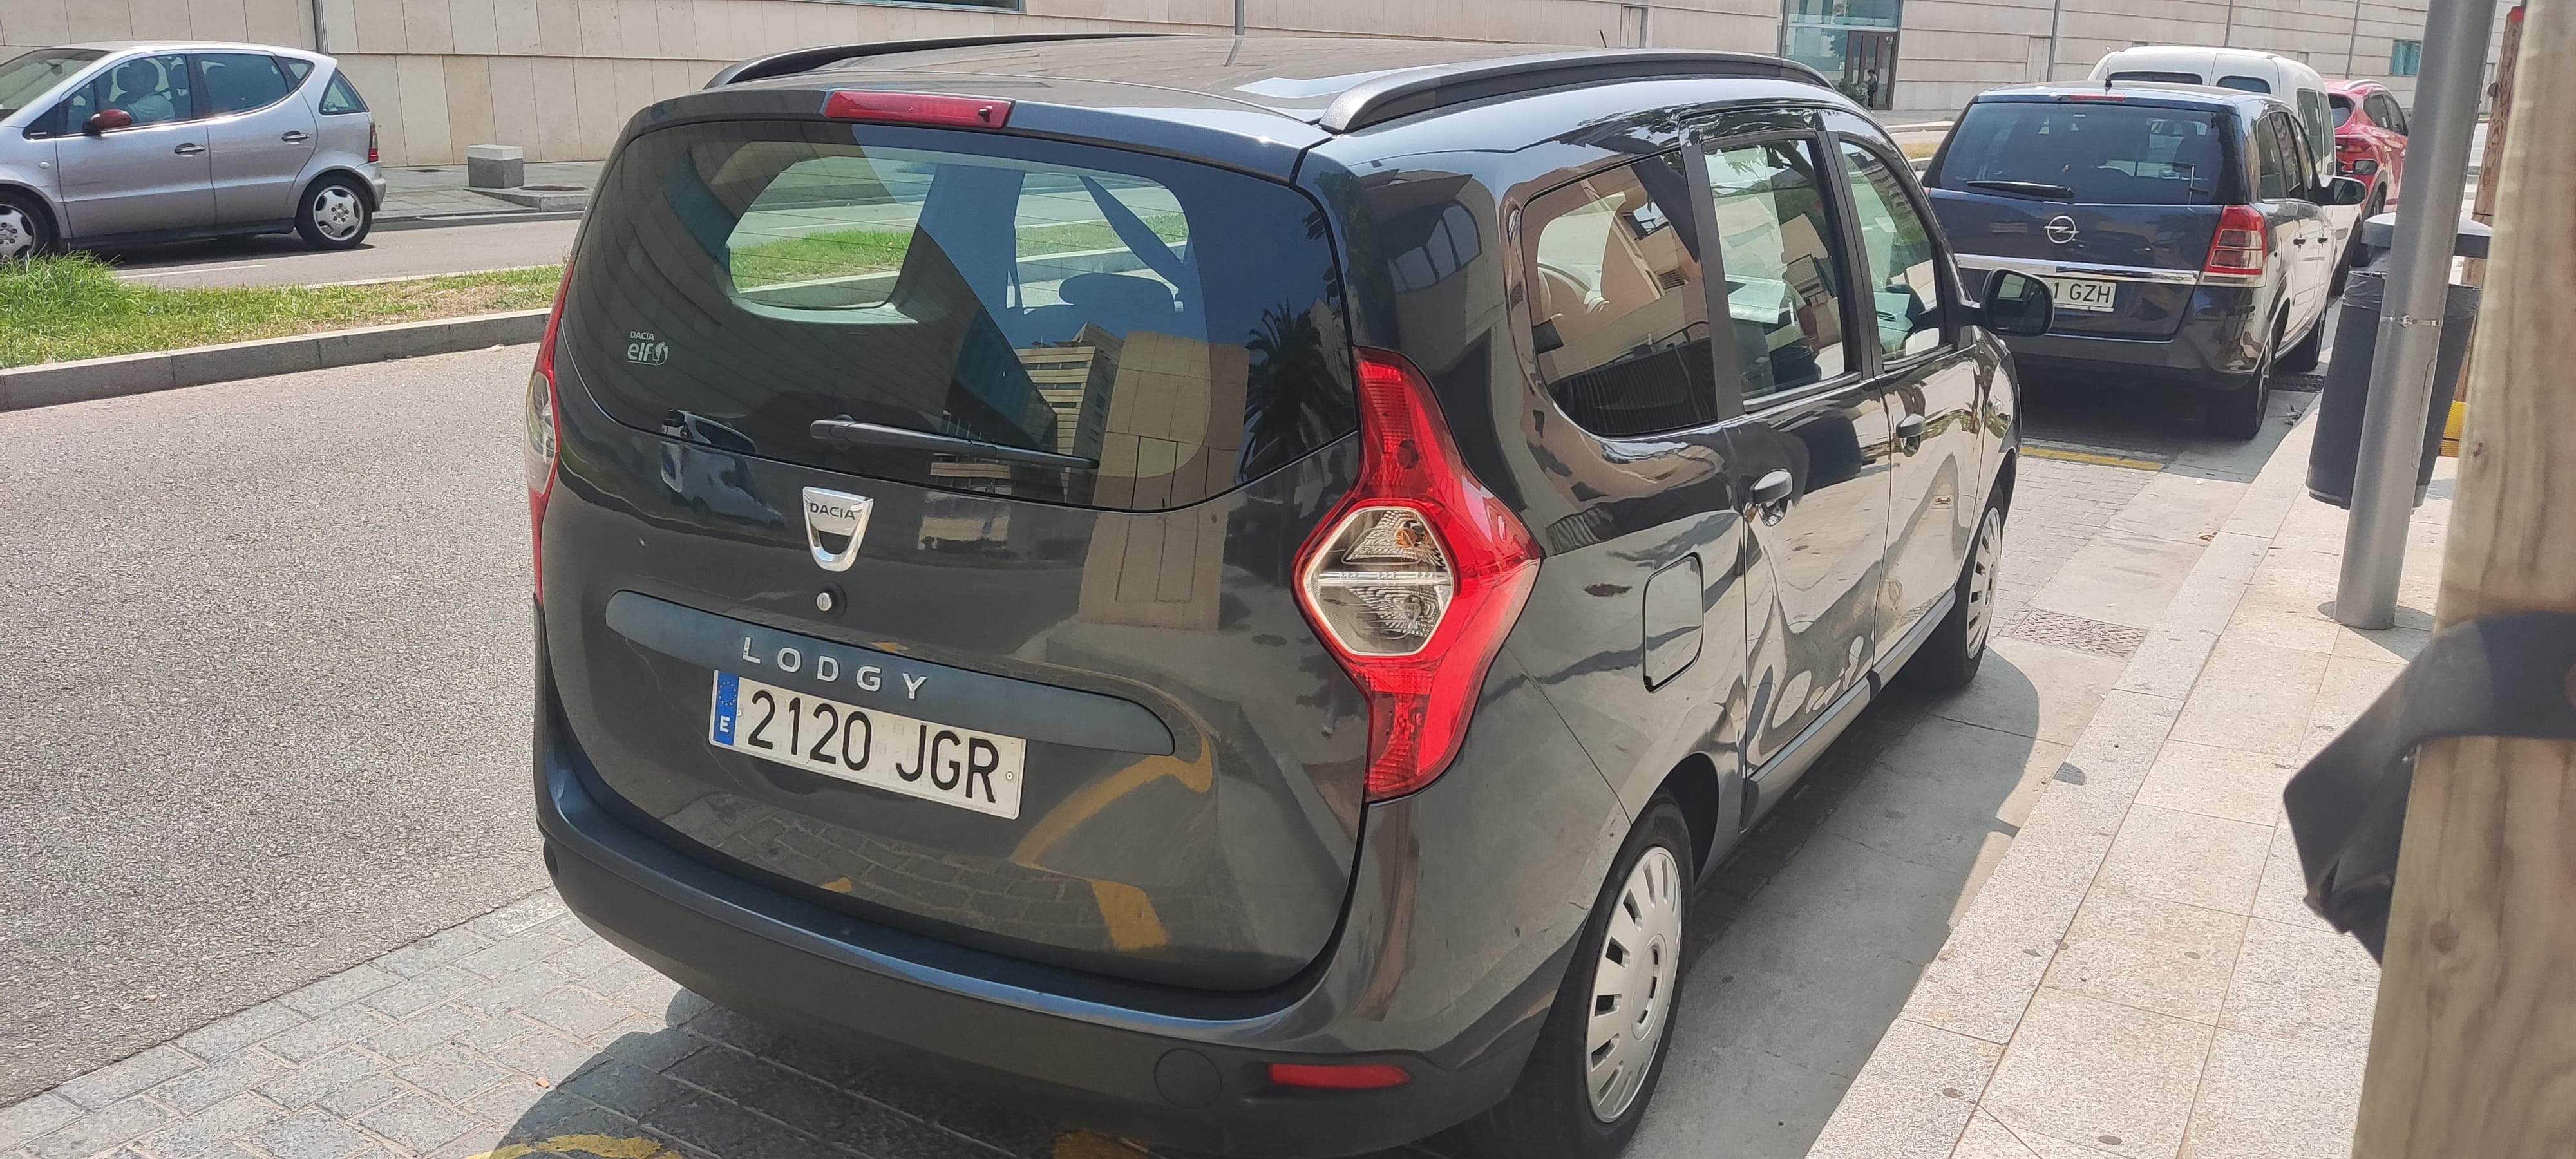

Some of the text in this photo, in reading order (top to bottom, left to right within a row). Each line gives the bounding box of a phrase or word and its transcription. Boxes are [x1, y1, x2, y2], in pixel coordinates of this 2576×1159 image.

[2069, 283, 2111, 304] GZH
[630, 330, 654, 341] DACIA
[627, 342, 654, 361] elf
[810, 502, 856, 520] DACIA
[743, 637, 928, 700] LODGY
[719, 715, 731, 733] E
[748, 690, 999, 804] 2120 JGR
